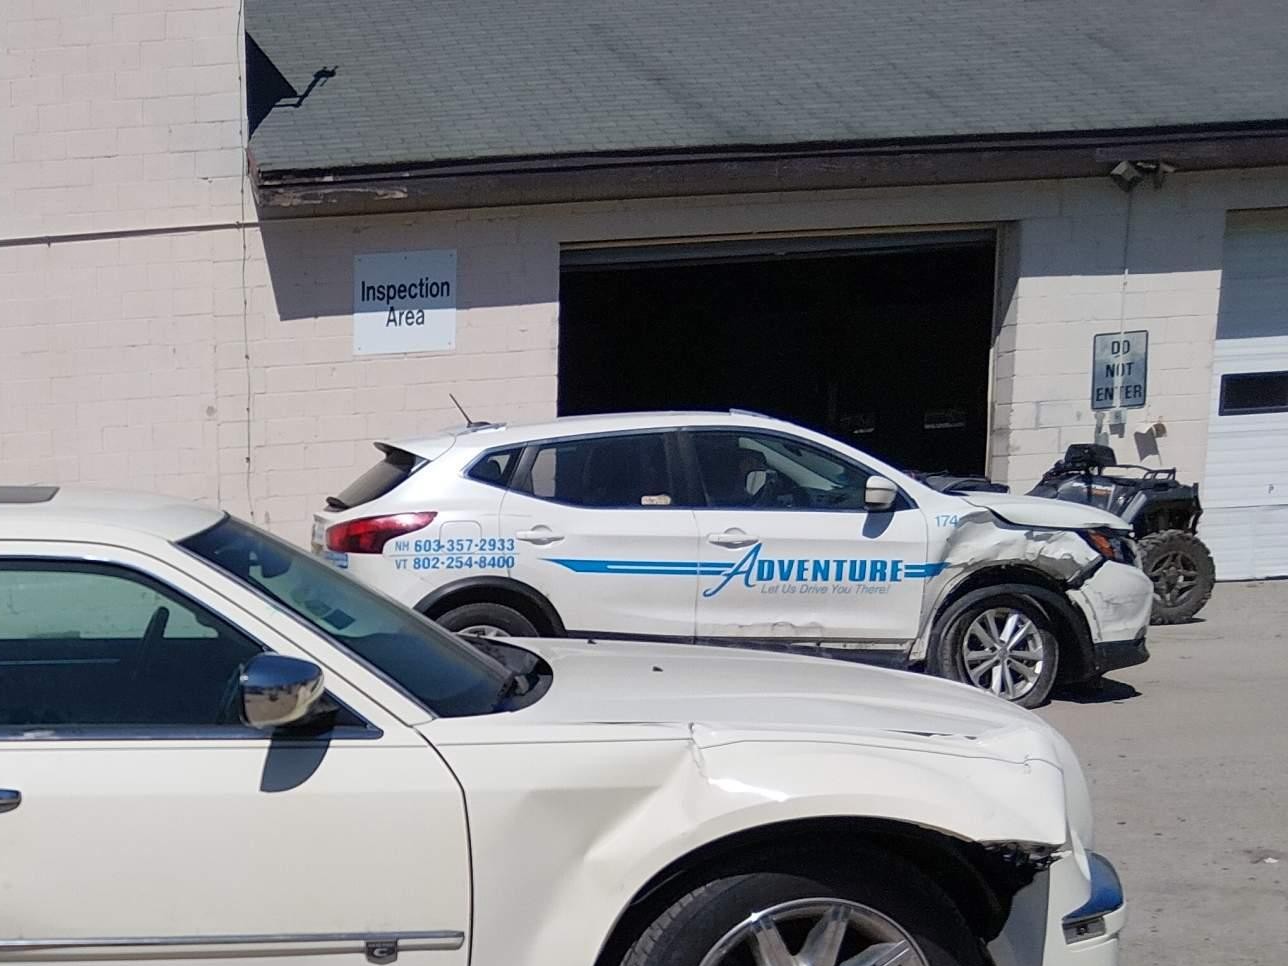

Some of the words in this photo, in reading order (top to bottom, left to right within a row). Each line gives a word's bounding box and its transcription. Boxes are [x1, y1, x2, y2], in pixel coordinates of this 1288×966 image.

[361, 277, 450, 305] Inspection
[386, 306, 425, 328] Area
[1105, 362, 1135, 378] NOT
[395, 541, 410, 552] NH
[395, 559, 408, 570] VT
[761, 584, 779, 595] Let
[781, 584, 797, 595] Us
[799, 584, 828, 595] Drive
[832, 584, 852, 595] You
[855, 584, 891, 595] There!
